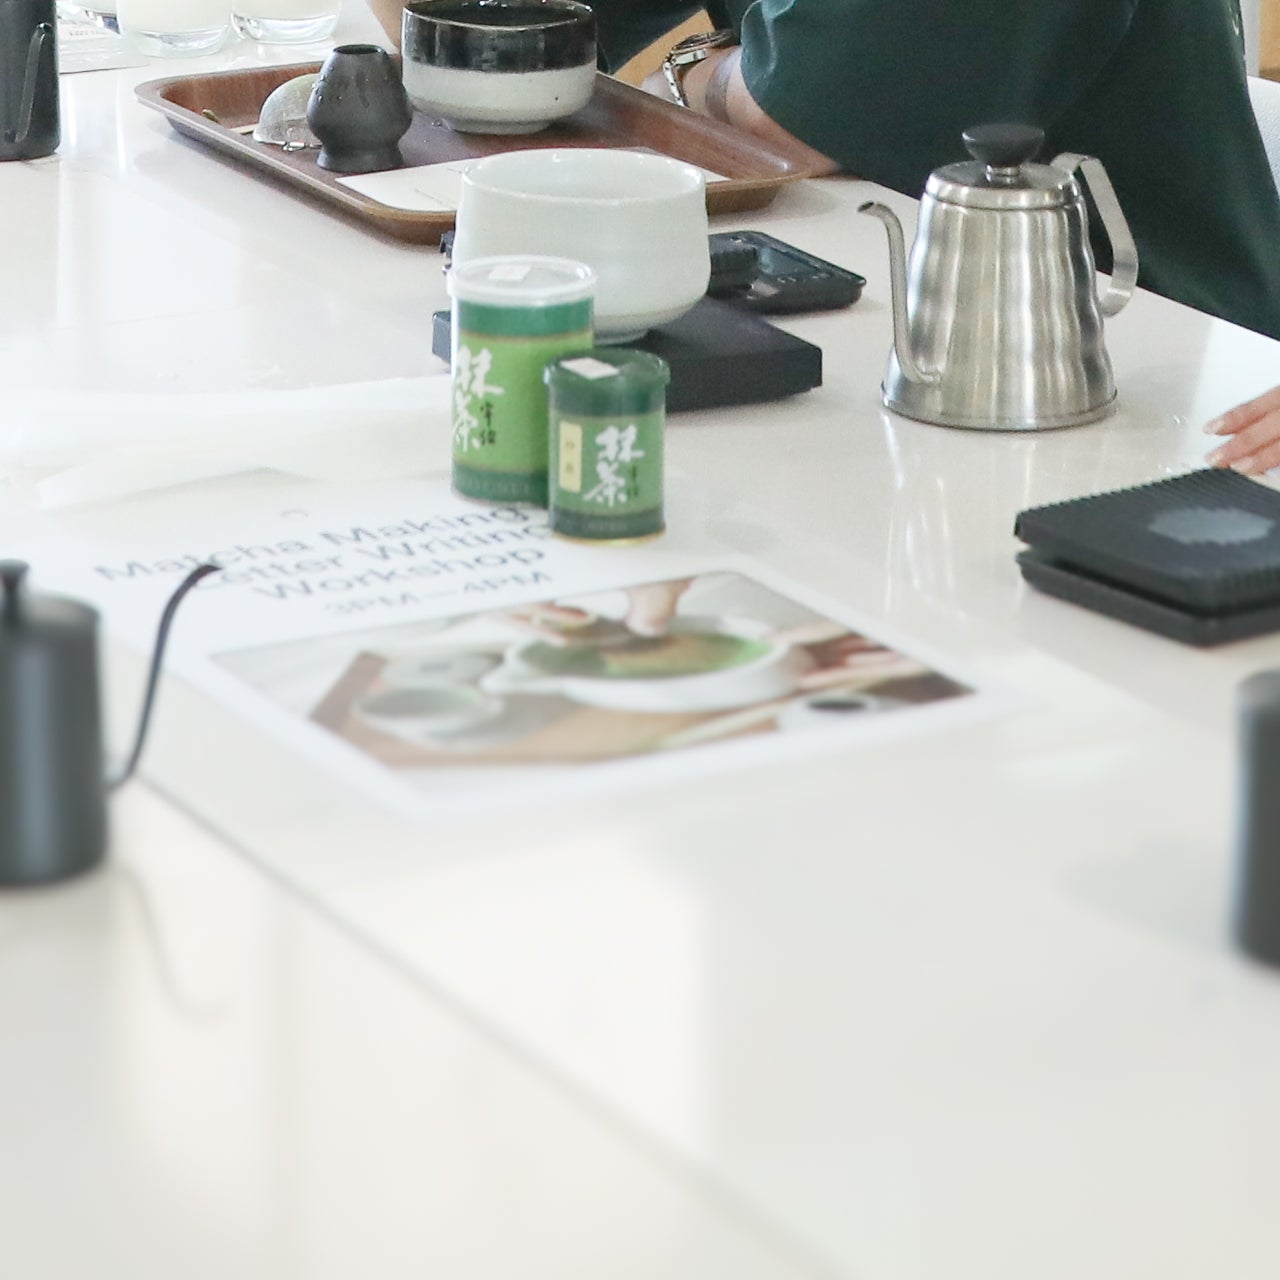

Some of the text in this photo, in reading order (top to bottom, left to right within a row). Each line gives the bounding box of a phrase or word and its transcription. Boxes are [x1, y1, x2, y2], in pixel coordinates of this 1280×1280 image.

[94, 507, 529, 581] Matcha Making
[252, 548, 544, 599] Workshop
